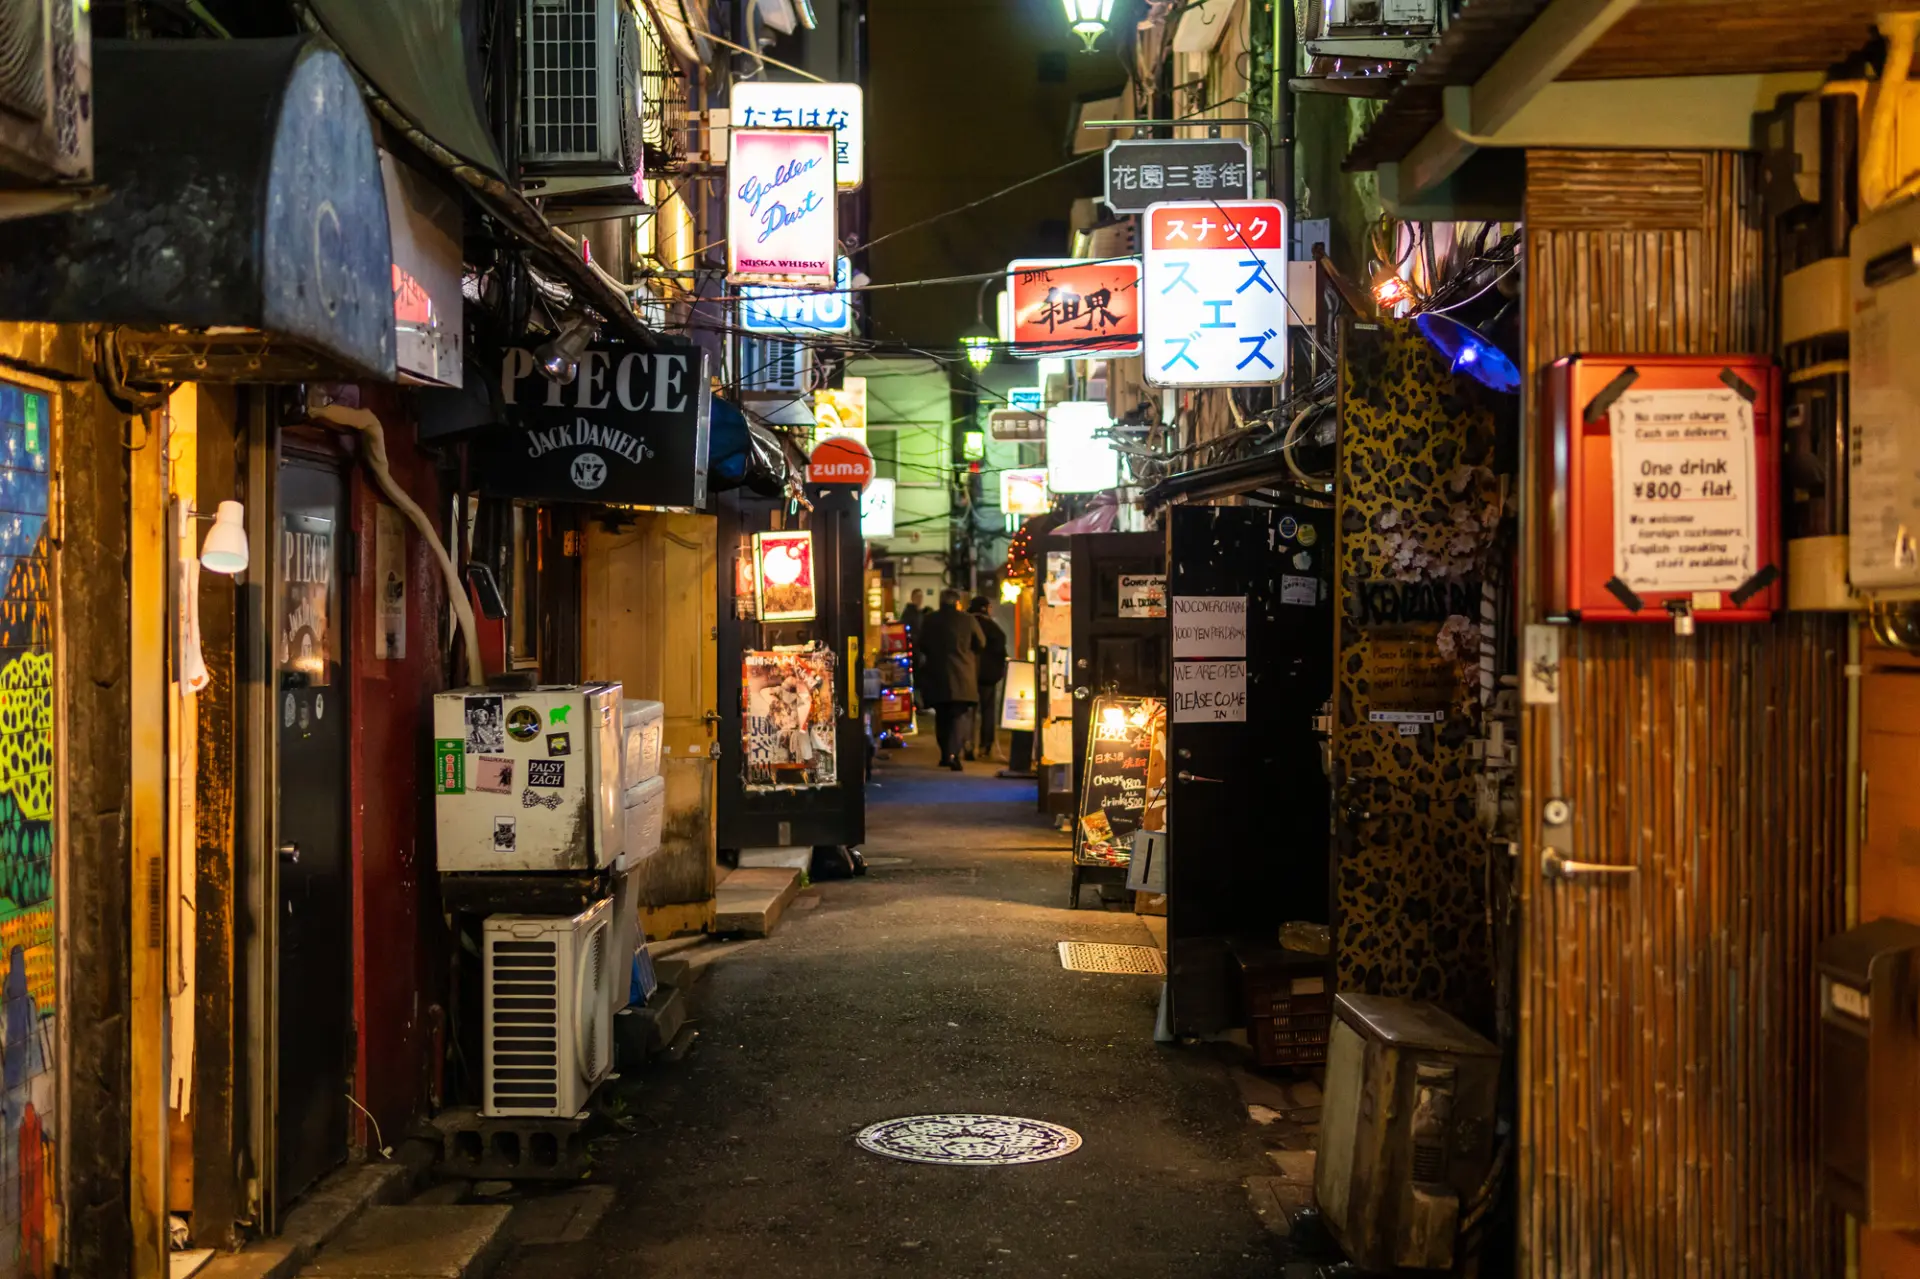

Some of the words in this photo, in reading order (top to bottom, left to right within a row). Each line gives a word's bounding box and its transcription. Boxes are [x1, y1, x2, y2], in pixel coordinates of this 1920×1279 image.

[1112, 161, 1246, 190] 花園三番街
[737, 157, 822, 216] Golden
[757, 190, 824, 243] Dust
[1165, 216, 1269, 241] スナック
[740, 259, 776, 268] NIKKA
[778, 260, 826, 269] WHISKY
[1029, 286, 1128, 335] 租界
[527, 424, 574, 458] JACK
[1641, 459, 1674, 476] One
[1680, 458, 1728, 475] drink
[285, 531, 329, 584] PIECE
[1174, 600, 1190, 614] NO
[1191, 600, 1219, 614] COVER
[1174, 626, 1192, 642] 1000
[1193, 627, 1211, 640] YEN
[1174, 664, 1192, 680] WE
[1195, 664, 1217, 680] ARE
[1218, 664, 1245, 679] OPEN
[1174, 690, 1213, 713] PLEASE
[1214, 691, 1246, 708] COME
[1213, 710, 1228, 719] IN
[529, 761, 565, 774] PALSY
[530, 774, 562, 786] ZACH
